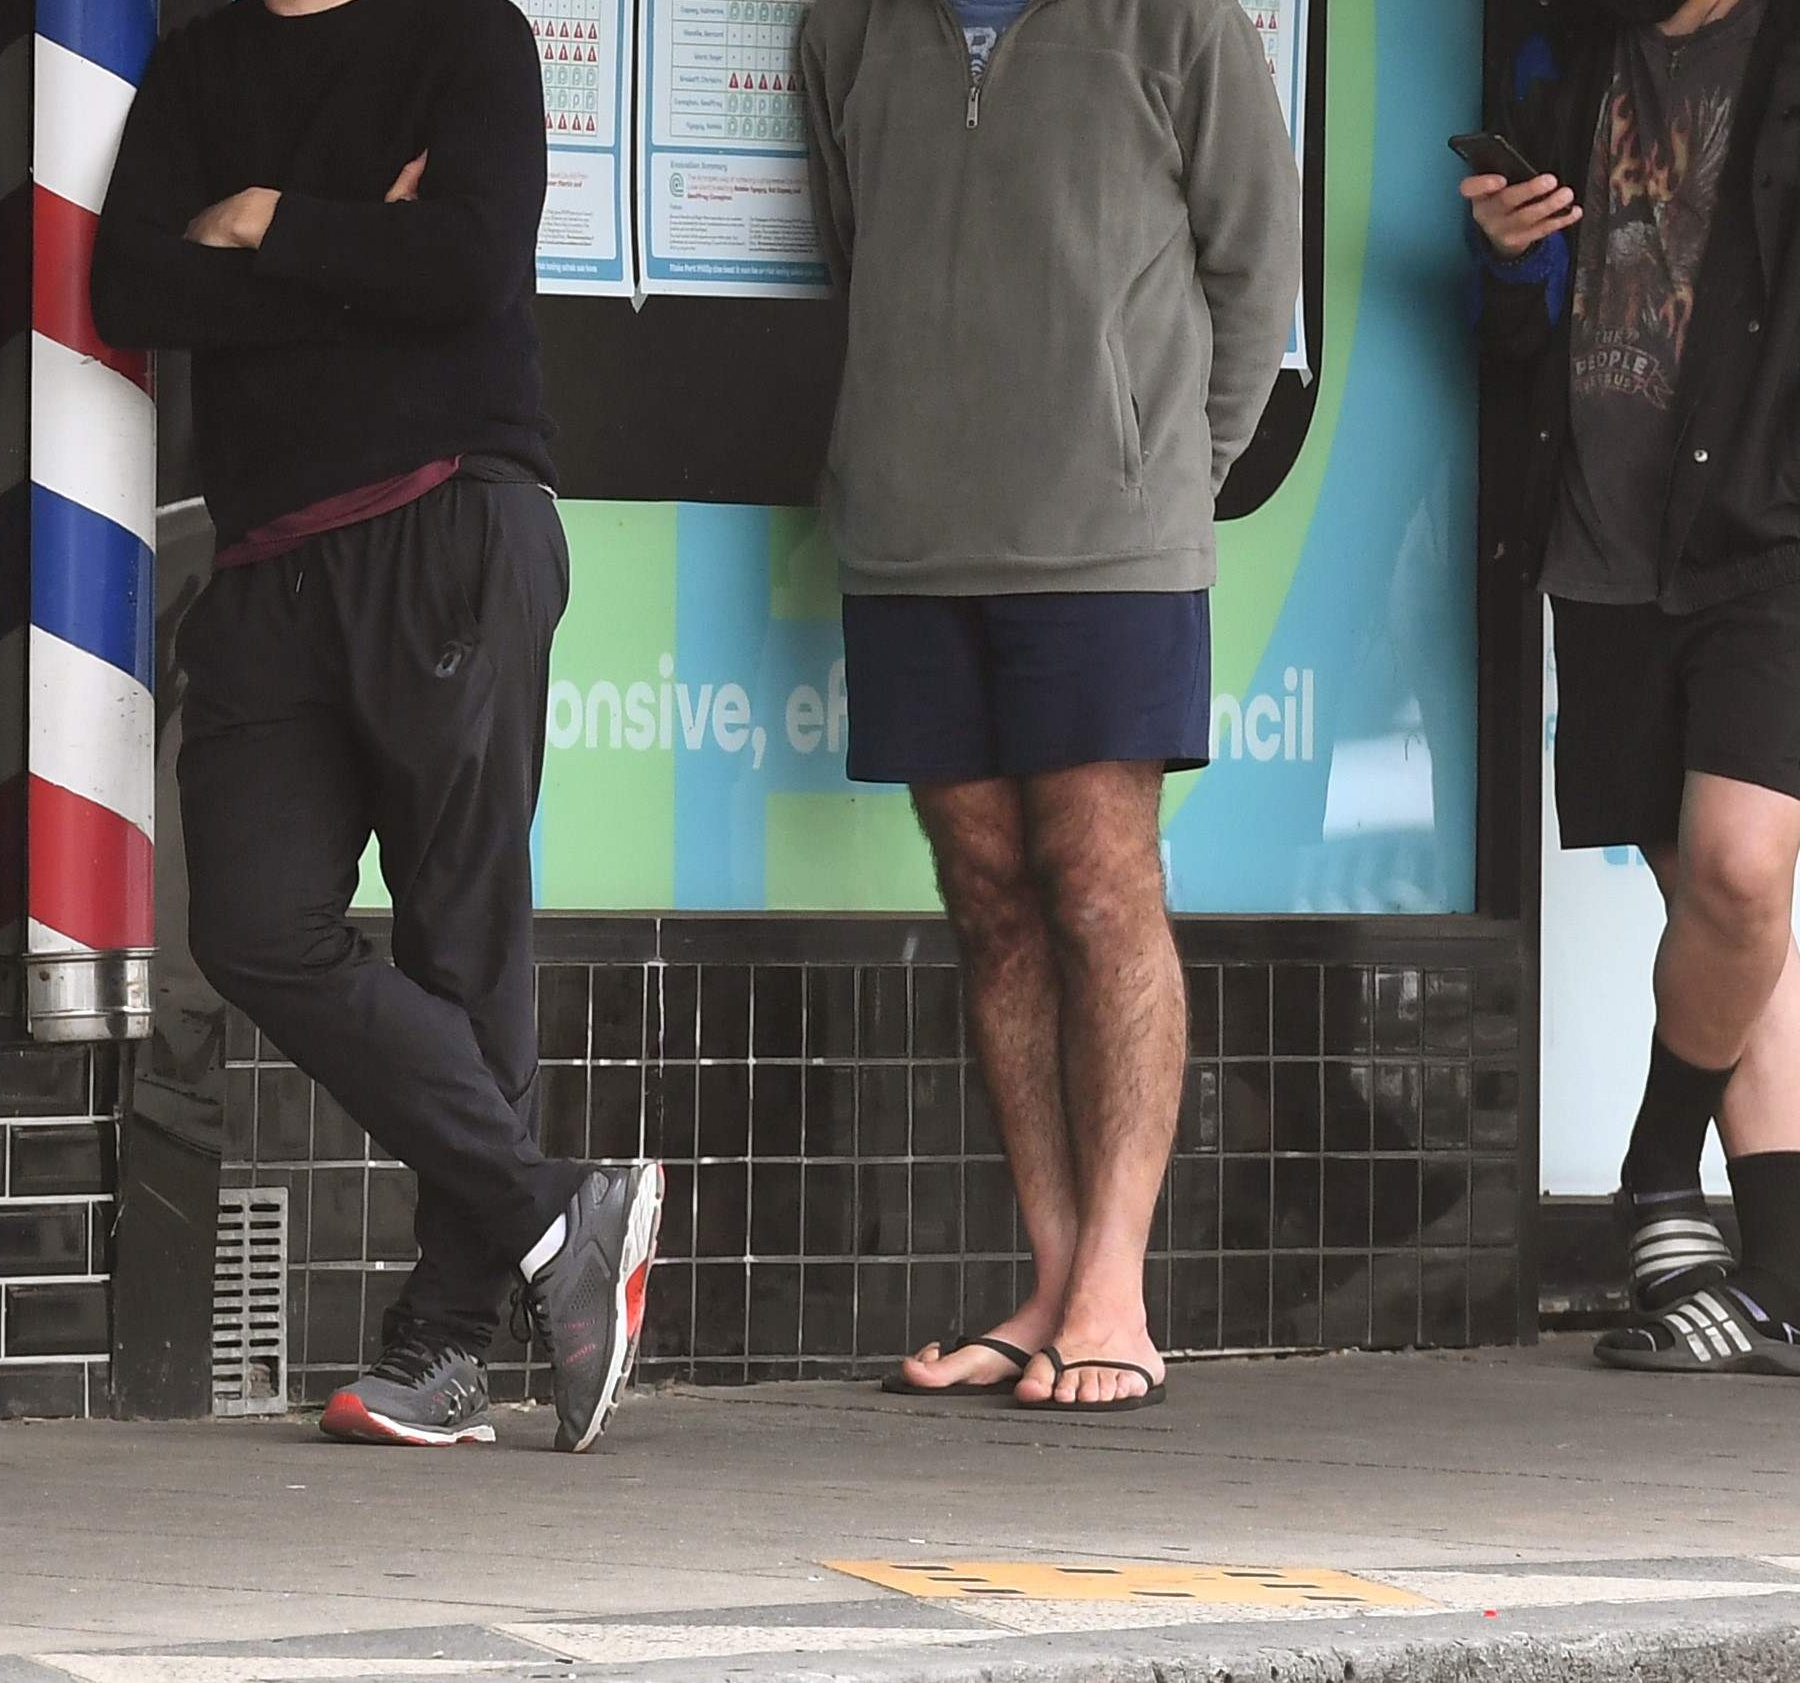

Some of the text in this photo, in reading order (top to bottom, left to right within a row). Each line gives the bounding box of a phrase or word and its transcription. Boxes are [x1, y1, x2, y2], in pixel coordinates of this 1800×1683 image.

[1575, 349, 1648, 375] PEOPLE
[547, 652, 767, 769] onsive,
[1211, 665, 1314, 762] ncil
